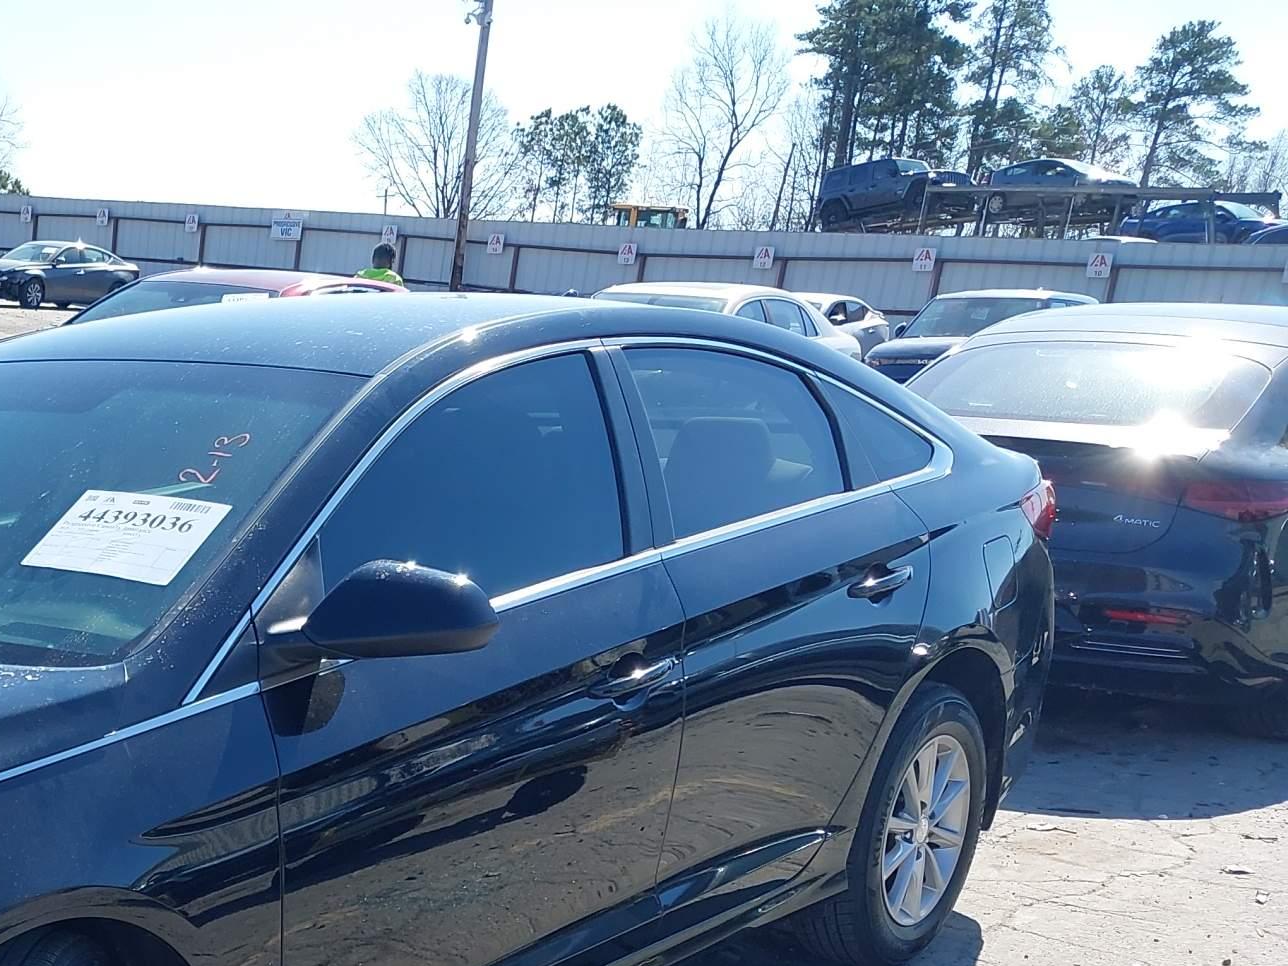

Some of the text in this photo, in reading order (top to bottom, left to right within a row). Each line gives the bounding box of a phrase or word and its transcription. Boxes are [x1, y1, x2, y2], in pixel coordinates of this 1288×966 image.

[280, 227, 293, 237] VIC
[178, 432, 251, 484] 2-13
[78, 507, 200, 534] 44393036
